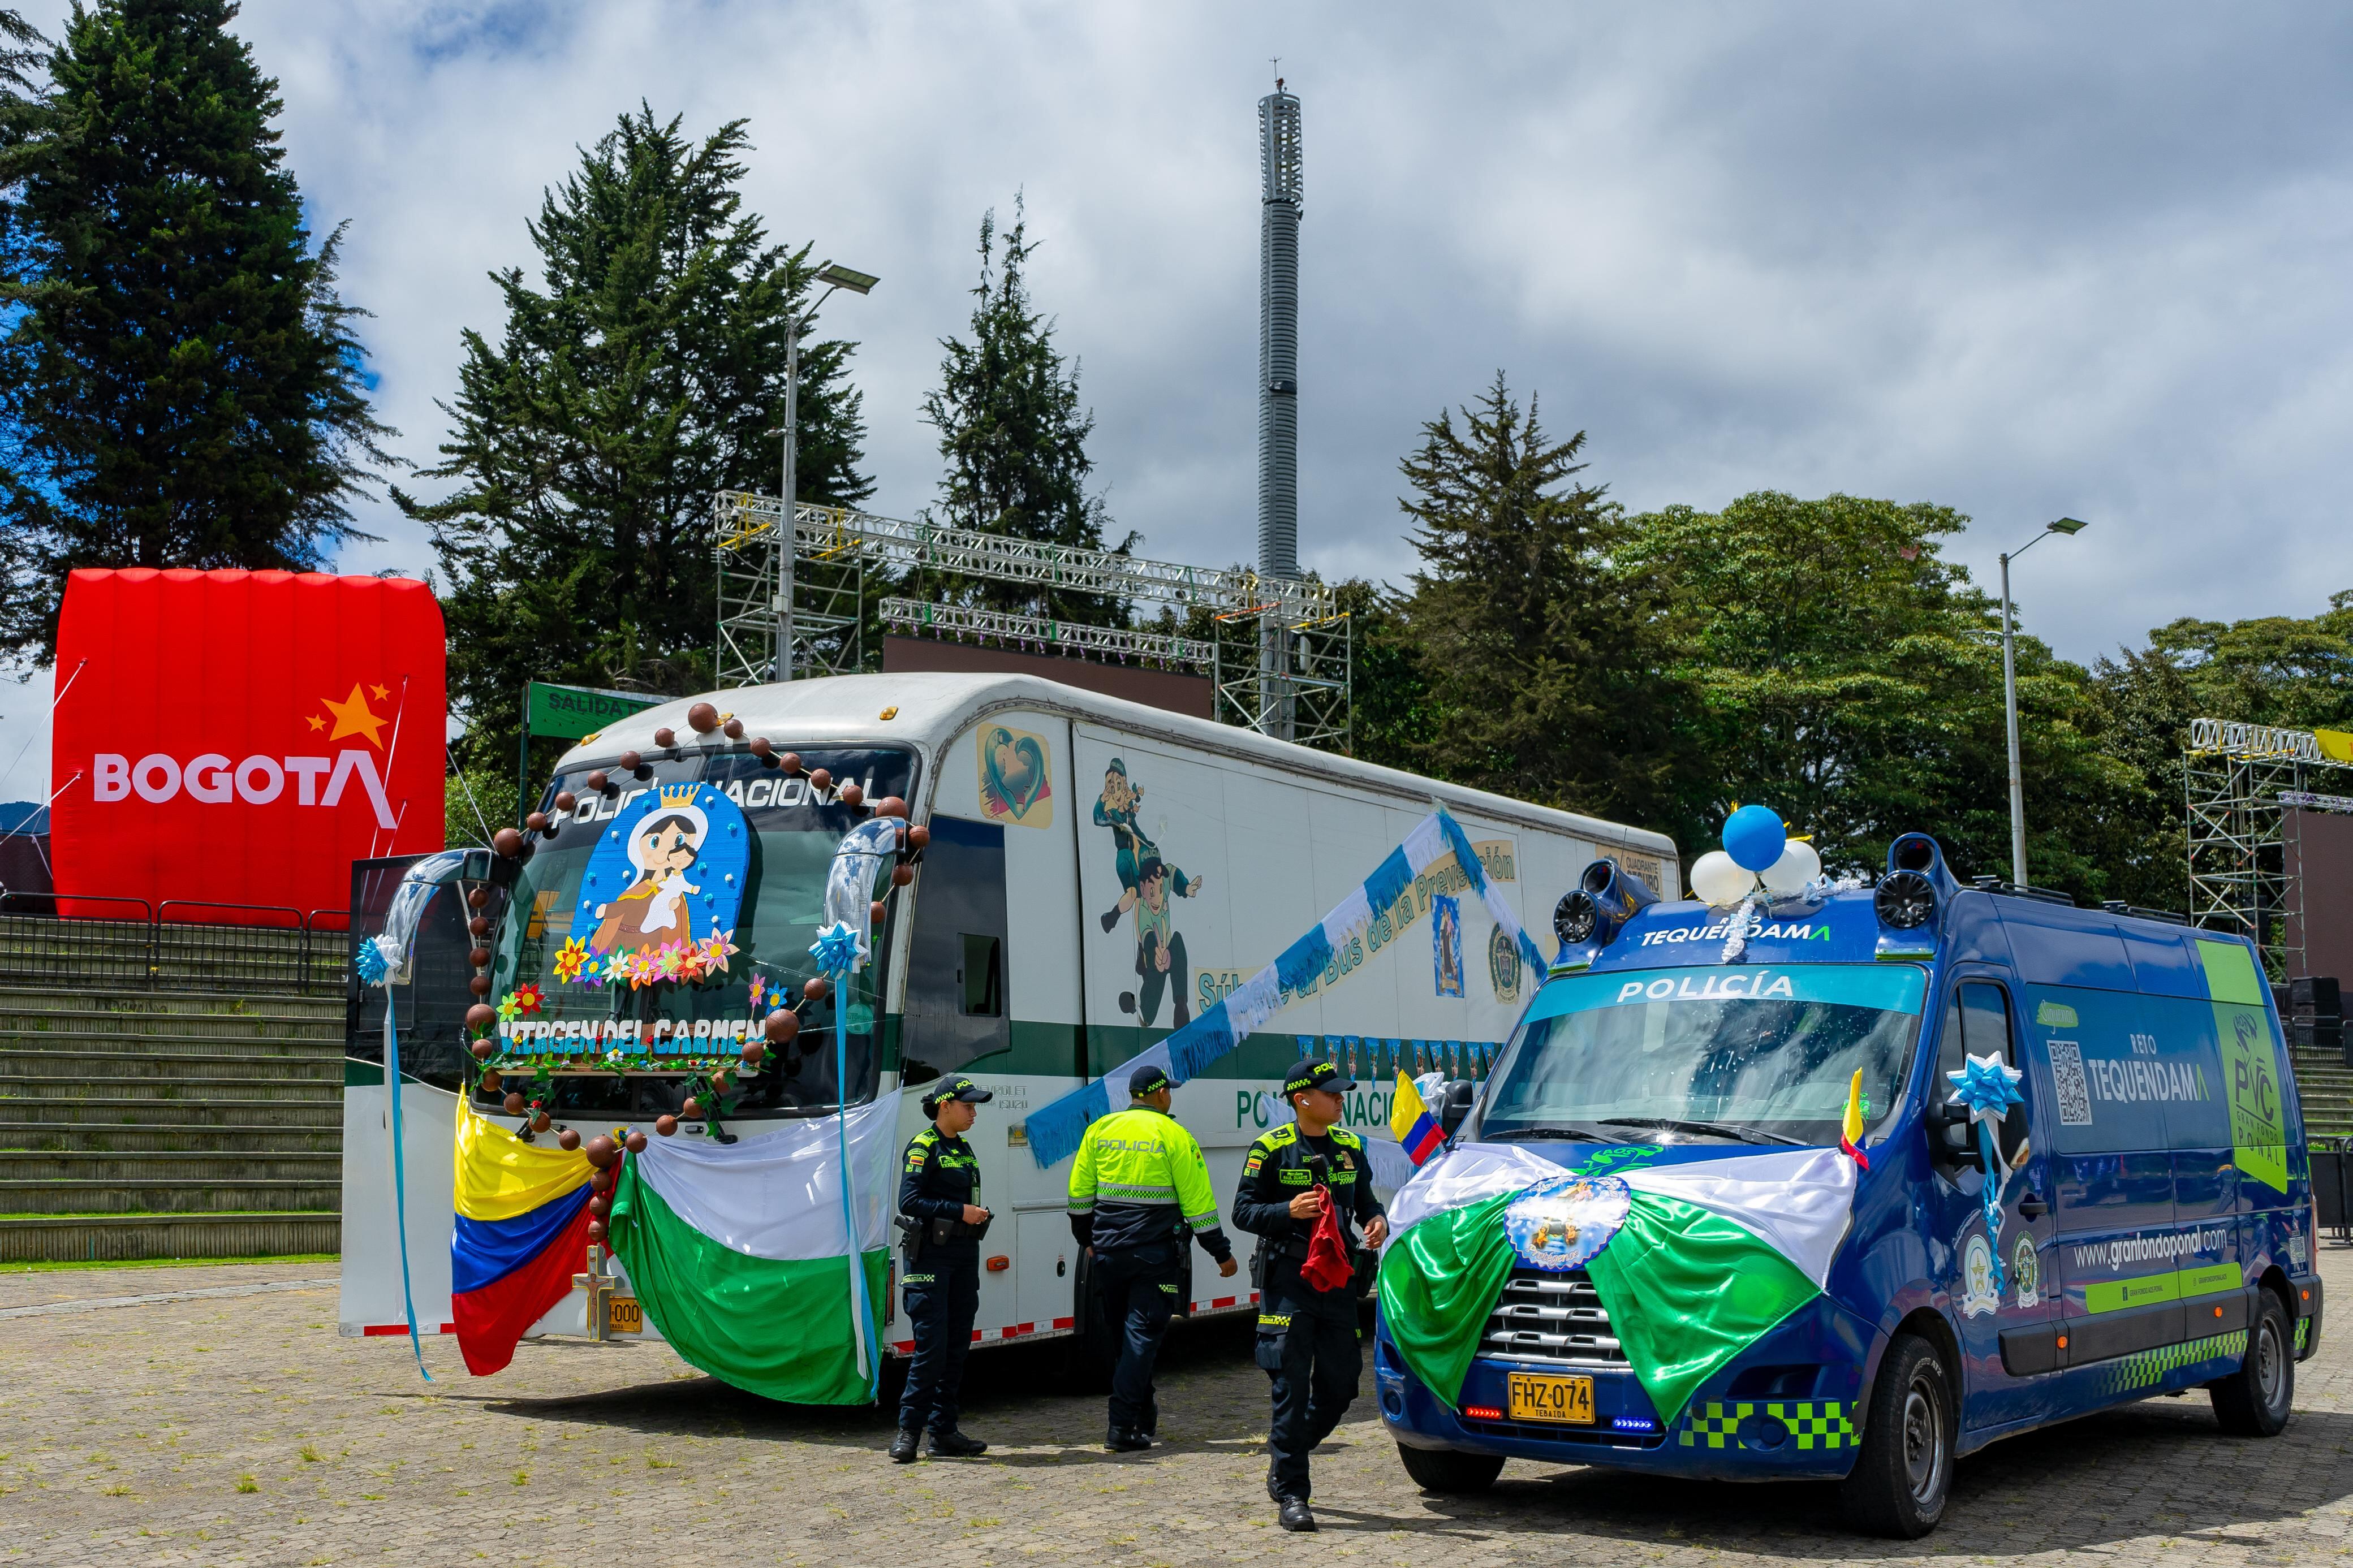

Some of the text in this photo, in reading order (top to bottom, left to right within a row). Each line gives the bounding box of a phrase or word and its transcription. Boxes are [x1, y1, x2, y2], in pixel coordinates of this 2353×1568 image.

[548, 692, 622, 718] SALIDA
[715, 777, 882, 807] ACIONAL
[1626, 857, 1658, 874] CUADRANTE
[1367, 914, 1393, 953] de
[1392, 895, 1415, 930] la
[1415, 846, 1515, 912] Preveción
[1719, 916, 1761, 925] RO
[1616, 970, 1794, 1003] POLICÍA
[498, 1019, 766, 1055] VIRGEN DEL CARMEN
[2130, 1034, 2157, 1055] RETO
[2088, 1059, 2210, 1104] TEQUENDAMA
[999, 1099, 1028, 1111] ISUZU
[2236, 1111, 2278, 1144] GRAN FONDO
[1098, 1139, 1166, 1154] POLICÍA
[2238, 1126, 2280, 1167] PONAL
[1535, 1409, 1566, 1418] TEBAIDA
